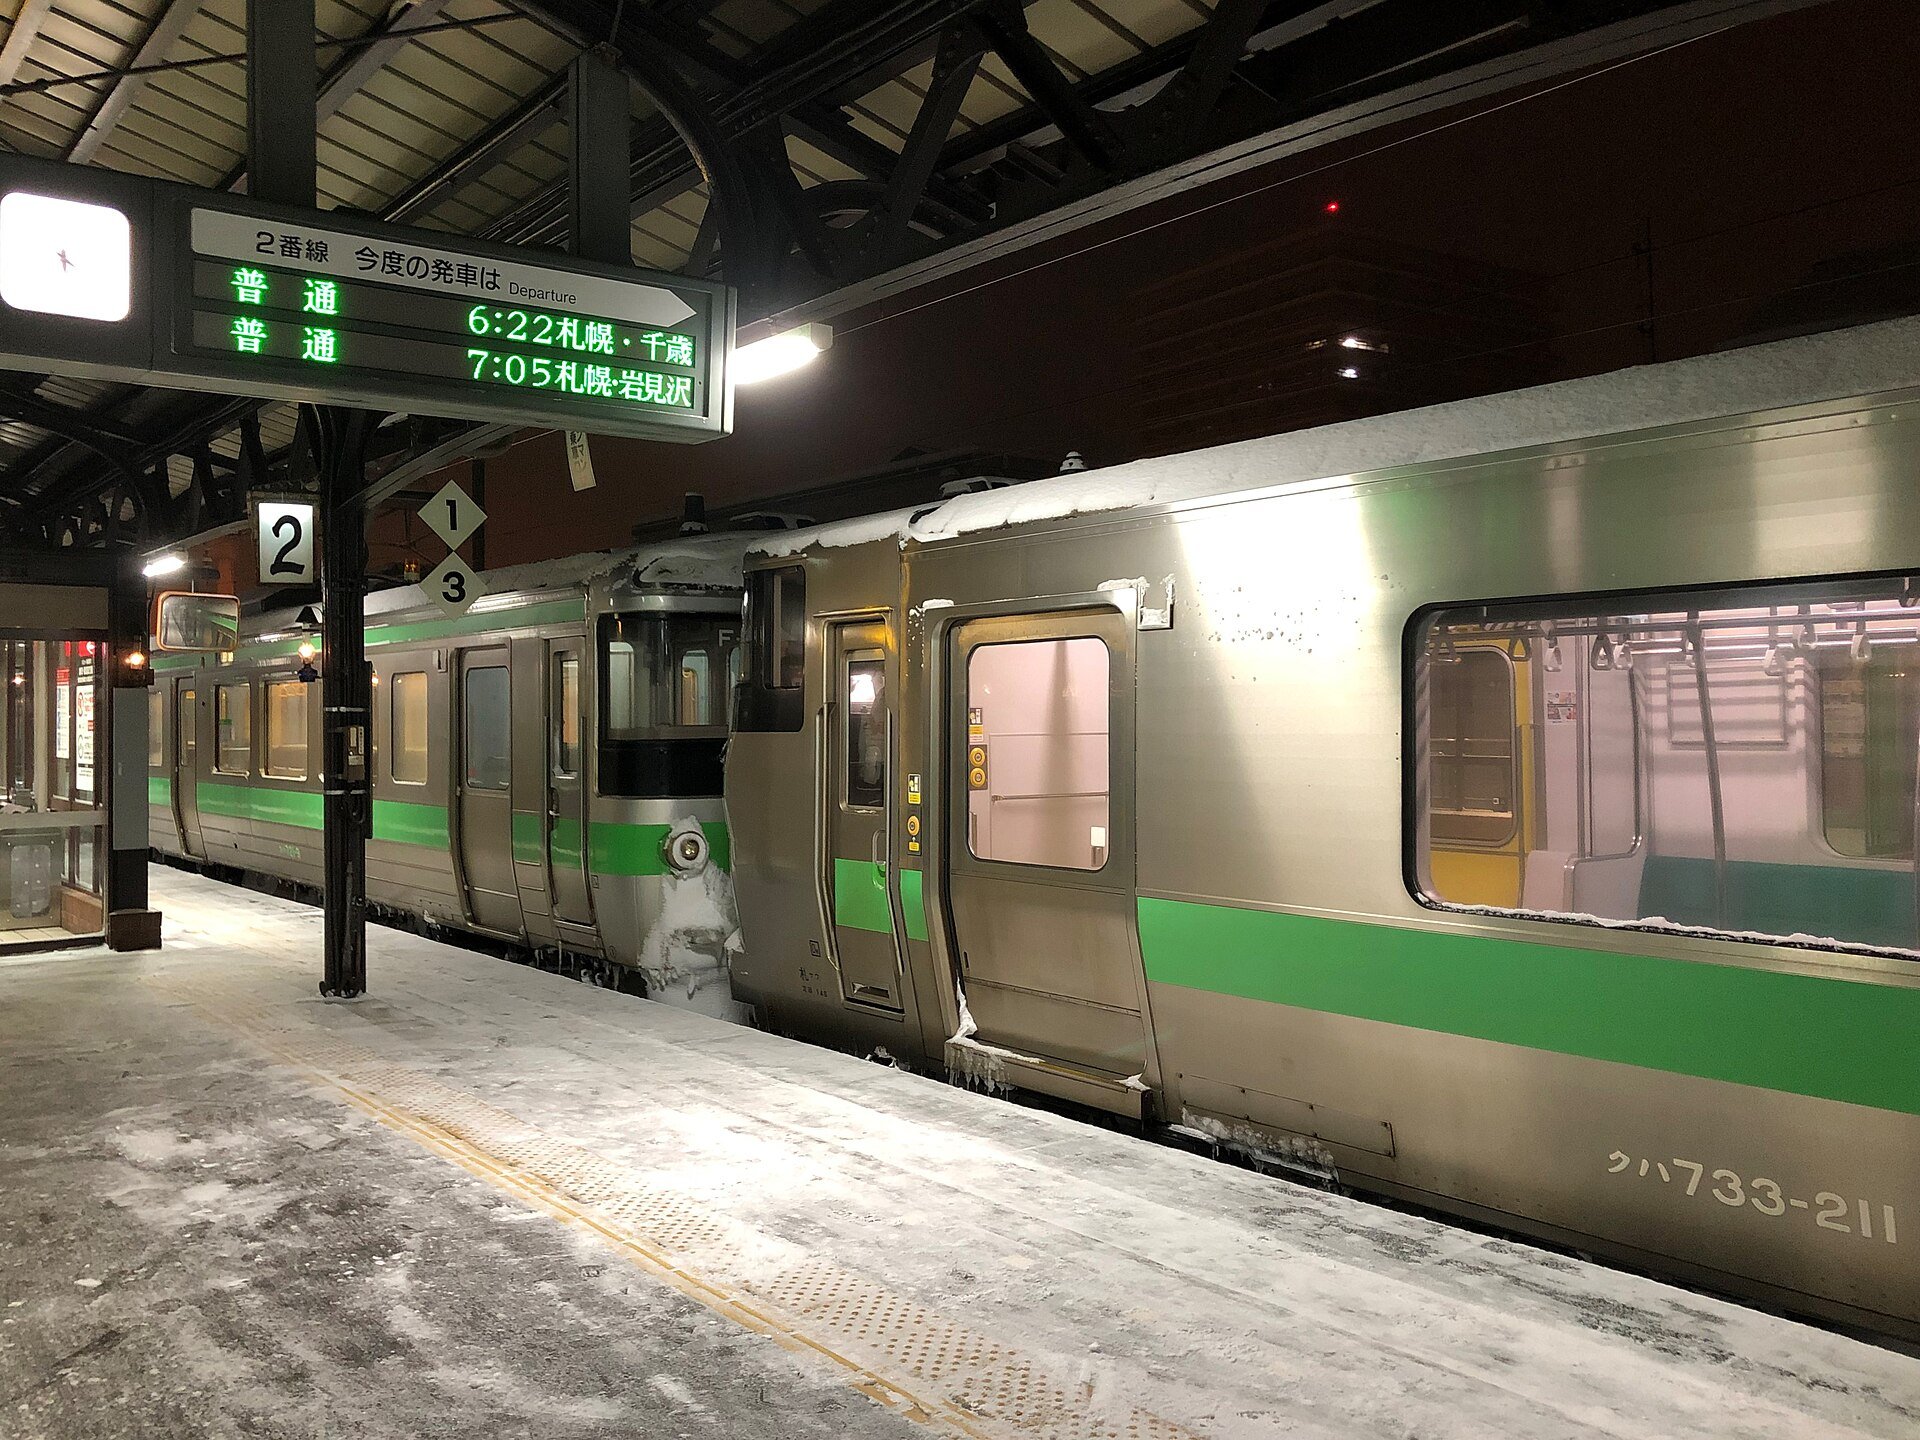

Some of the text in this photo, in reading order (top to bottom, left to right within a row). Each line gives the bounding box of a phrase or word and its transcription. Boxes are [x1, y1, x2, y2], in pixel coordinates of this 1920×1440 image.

[255, 231, 577, 305] 2番線 今度の発車は Departure
[269, 514, 306, 576] 2
[445, 499, 458, 531] 1
[441, 571, 467, 603] 3
[1607, 1150, 1898, 1244] クハ733-211
